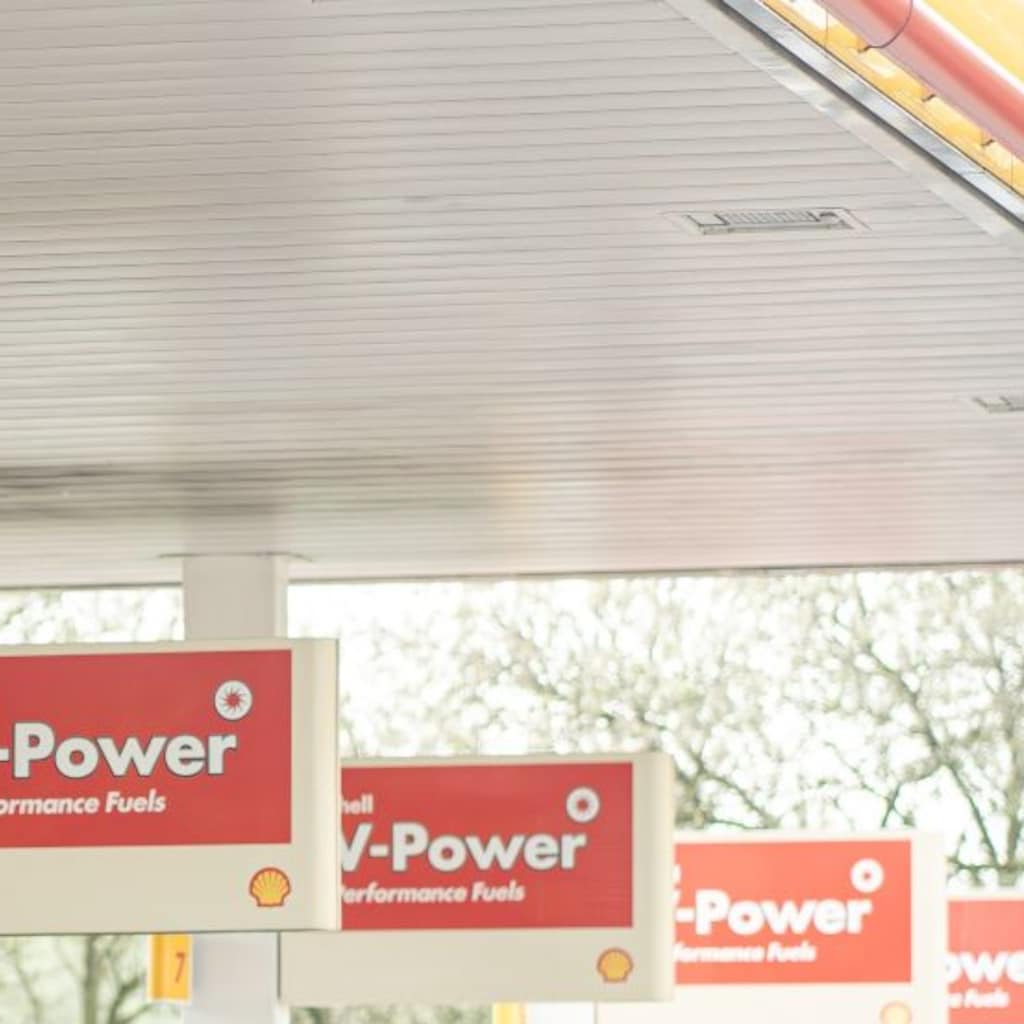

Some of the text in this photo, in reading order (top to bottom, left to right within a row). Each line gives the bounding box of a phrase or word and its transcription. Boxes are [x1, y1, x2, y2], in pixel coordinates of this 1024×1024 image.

[105, 789, 166, 814] Fuels
[341, 821, 588, 873] V-Power
[341, 882, 467, 904] erformance
[471, 880, 526, 902] Fuels
[675, 888, 873, 936] -Power
[175, 952, 187, 984] 7
